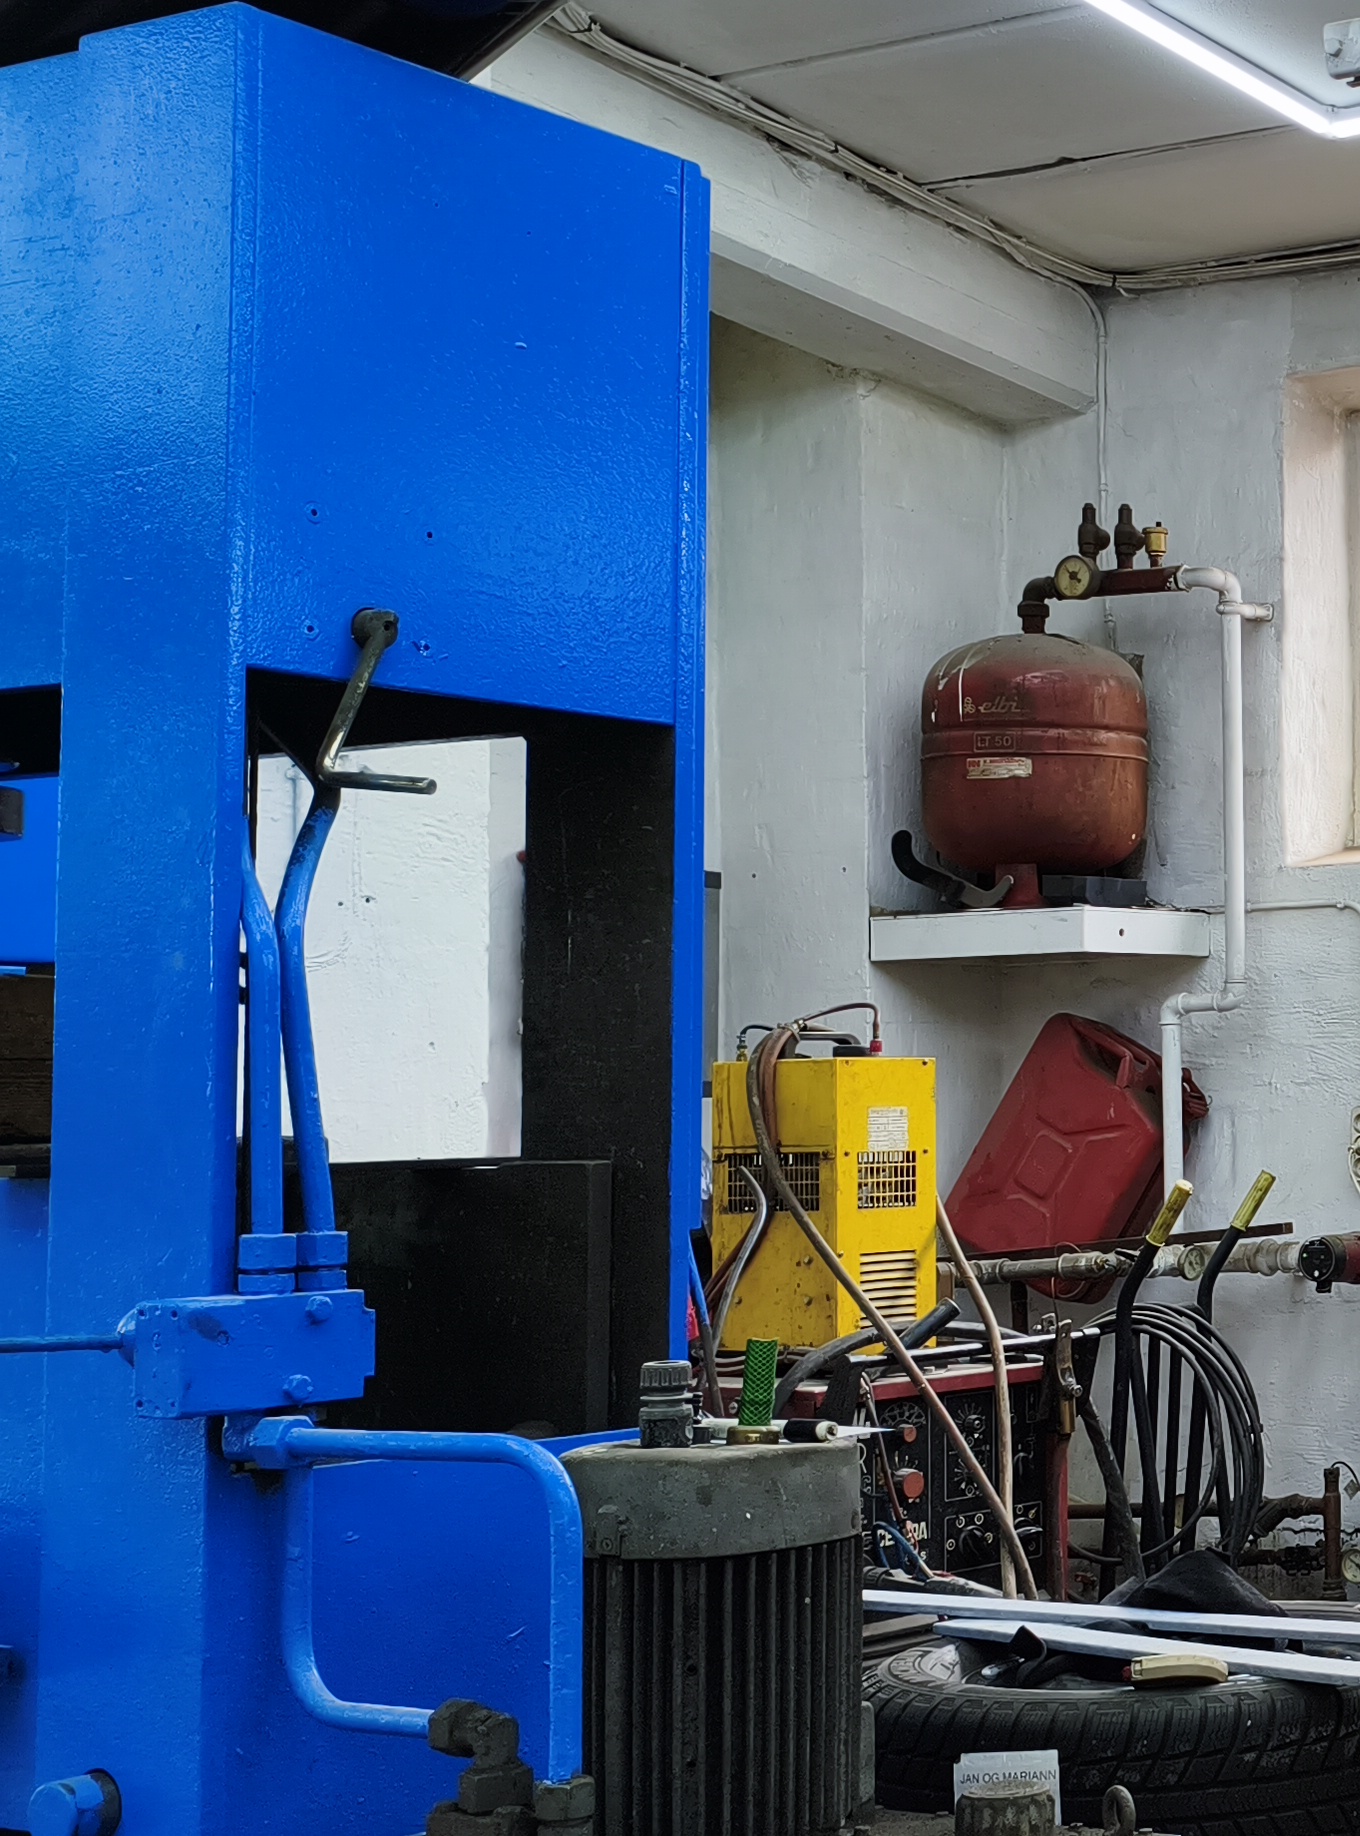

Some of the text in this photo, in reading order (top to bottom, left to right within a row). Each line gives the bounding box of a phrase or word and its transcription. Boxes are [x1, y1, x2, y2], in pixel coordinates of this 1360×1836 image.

[994, 735, 1012, 747] 50
[960, 1769, 1056, 1785] JAN OG MARIANN
